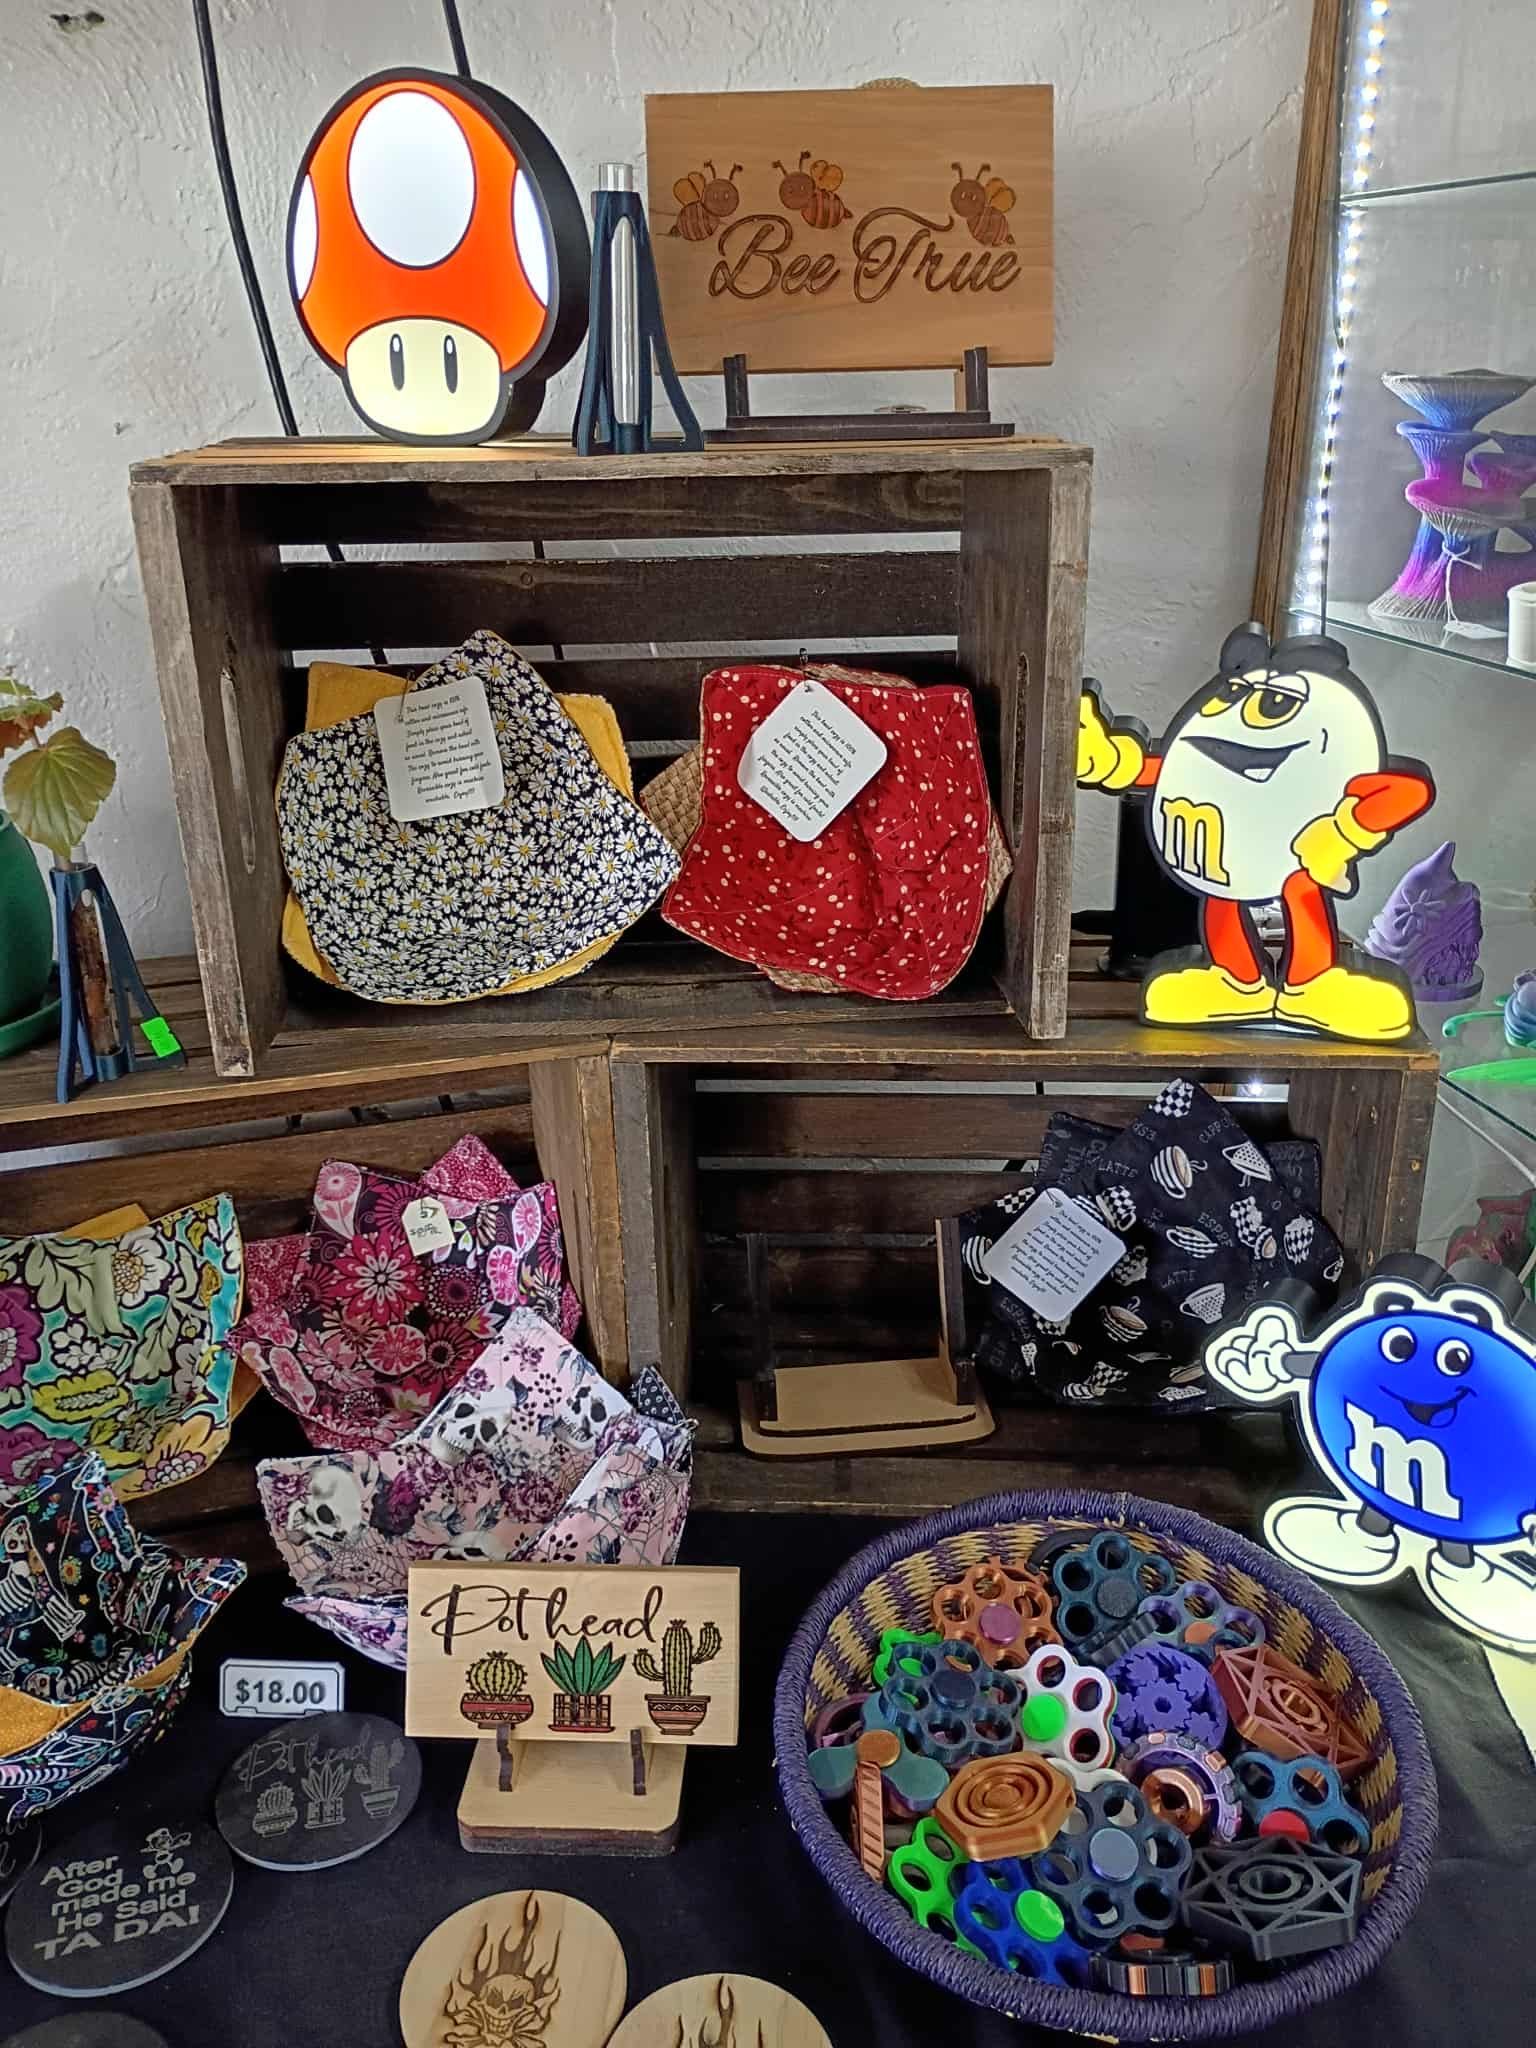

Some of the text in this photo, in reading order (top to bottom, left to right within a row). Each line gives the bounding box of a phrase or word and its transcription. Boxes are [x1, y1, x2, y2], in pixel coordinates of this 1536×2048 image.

[709, 207, 1021, 303] Bee True
[1160, 796, 1230, 887] m
[1344, 1396, 1463, 1522] m
[420, 1583, 664, 1656] Pot head
[235, 1678, 326, 1704] $18.00
[40, 1855, 119, 1886] After
[57, 1868, 124, 1898] God
[51, 1871, 197, 1917] made me
[57, 1888, 187, 1935] He Said
[33, 1930, 101, 1961] TA
